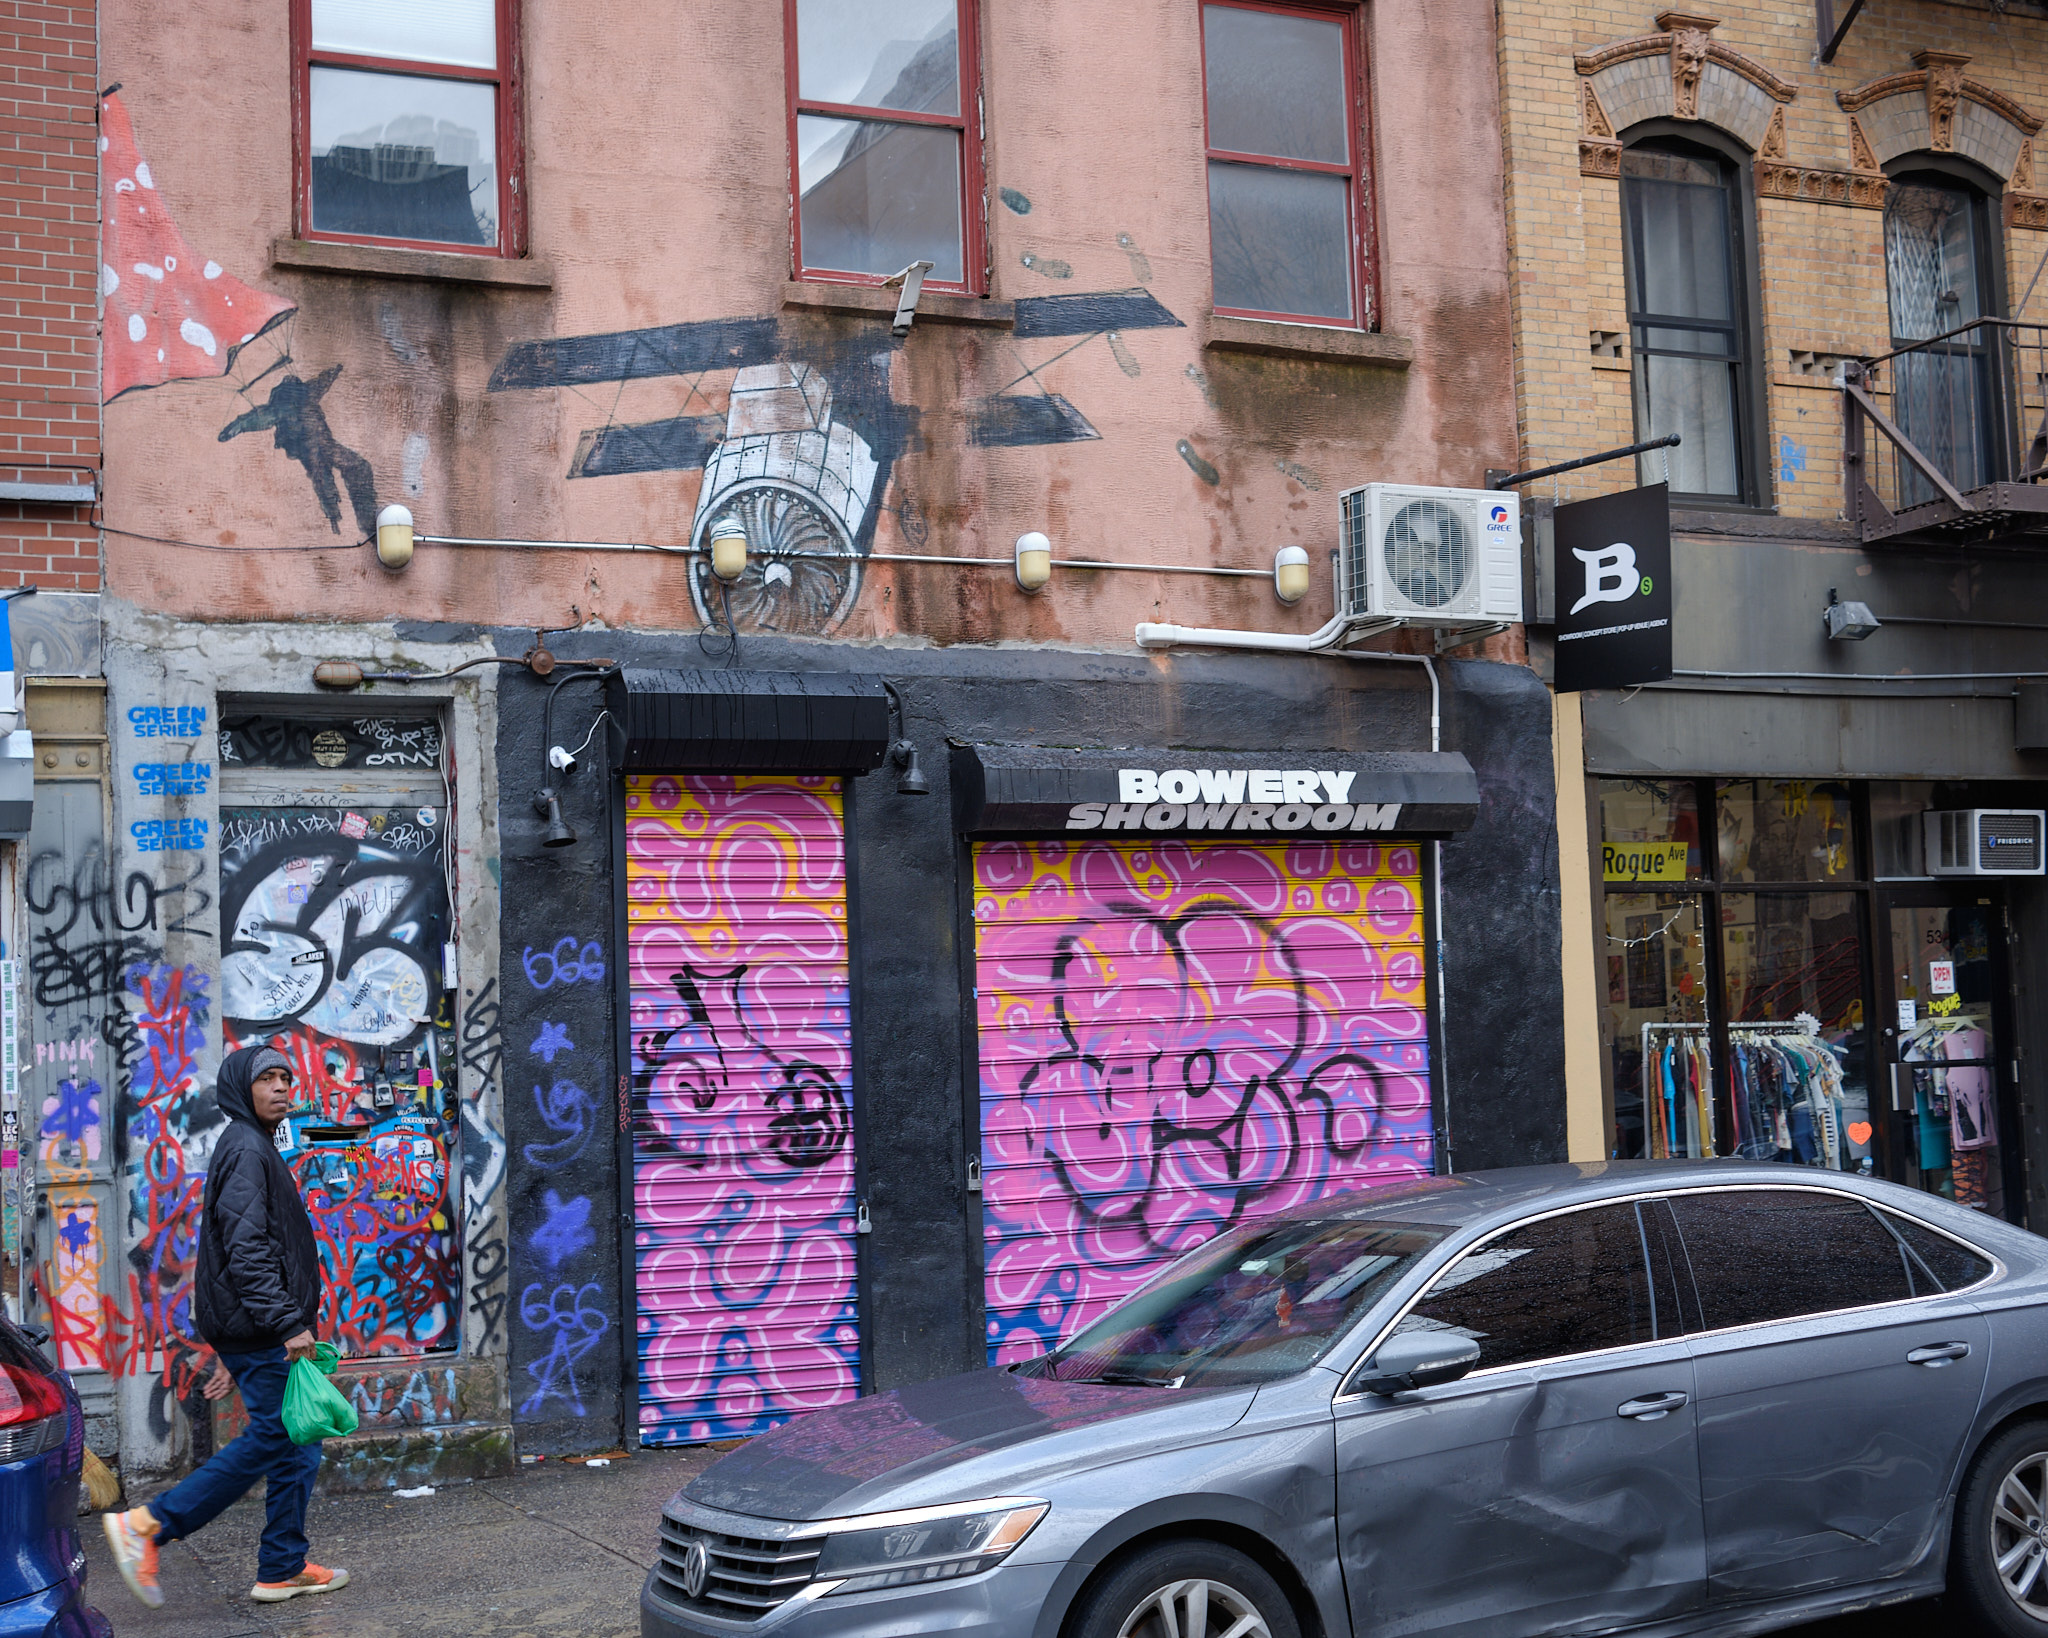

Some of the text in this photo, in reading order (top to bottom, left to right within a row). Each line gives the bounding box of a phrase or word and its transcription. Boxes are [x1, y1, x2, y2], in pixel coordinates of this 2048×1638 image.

[1487, 523, 1513, 533] GREE
[1569, 542, 1640, 616] B
[128, 706, 206, 724] GREEN
[134, 723, 202, 737] SERIES
[133, 763, 211, 781] GREEN
[139, 781, 207, 795] SERIES
[1117, 769, 1357, 804] BOWERY
[1065, 802, 1402, 831] SHOWROOM
[130, 818, 208, 838] GREEN
[137, 835, 205, 852] SERIES
[1996, 837, 2034, 845] FRIEDRICH
[1603, 845, 1685, 881] Rogue Ave
[1926, 929, 1942, 944] 53
[523, 936, 605, 990] 666
[1933, 966, 1951, 981] OPEN
[1928, 991, 1962, 1018] rogue
[36, 1037, 98, 1067] PINK
[520, 1283, 609, 1334] 666
